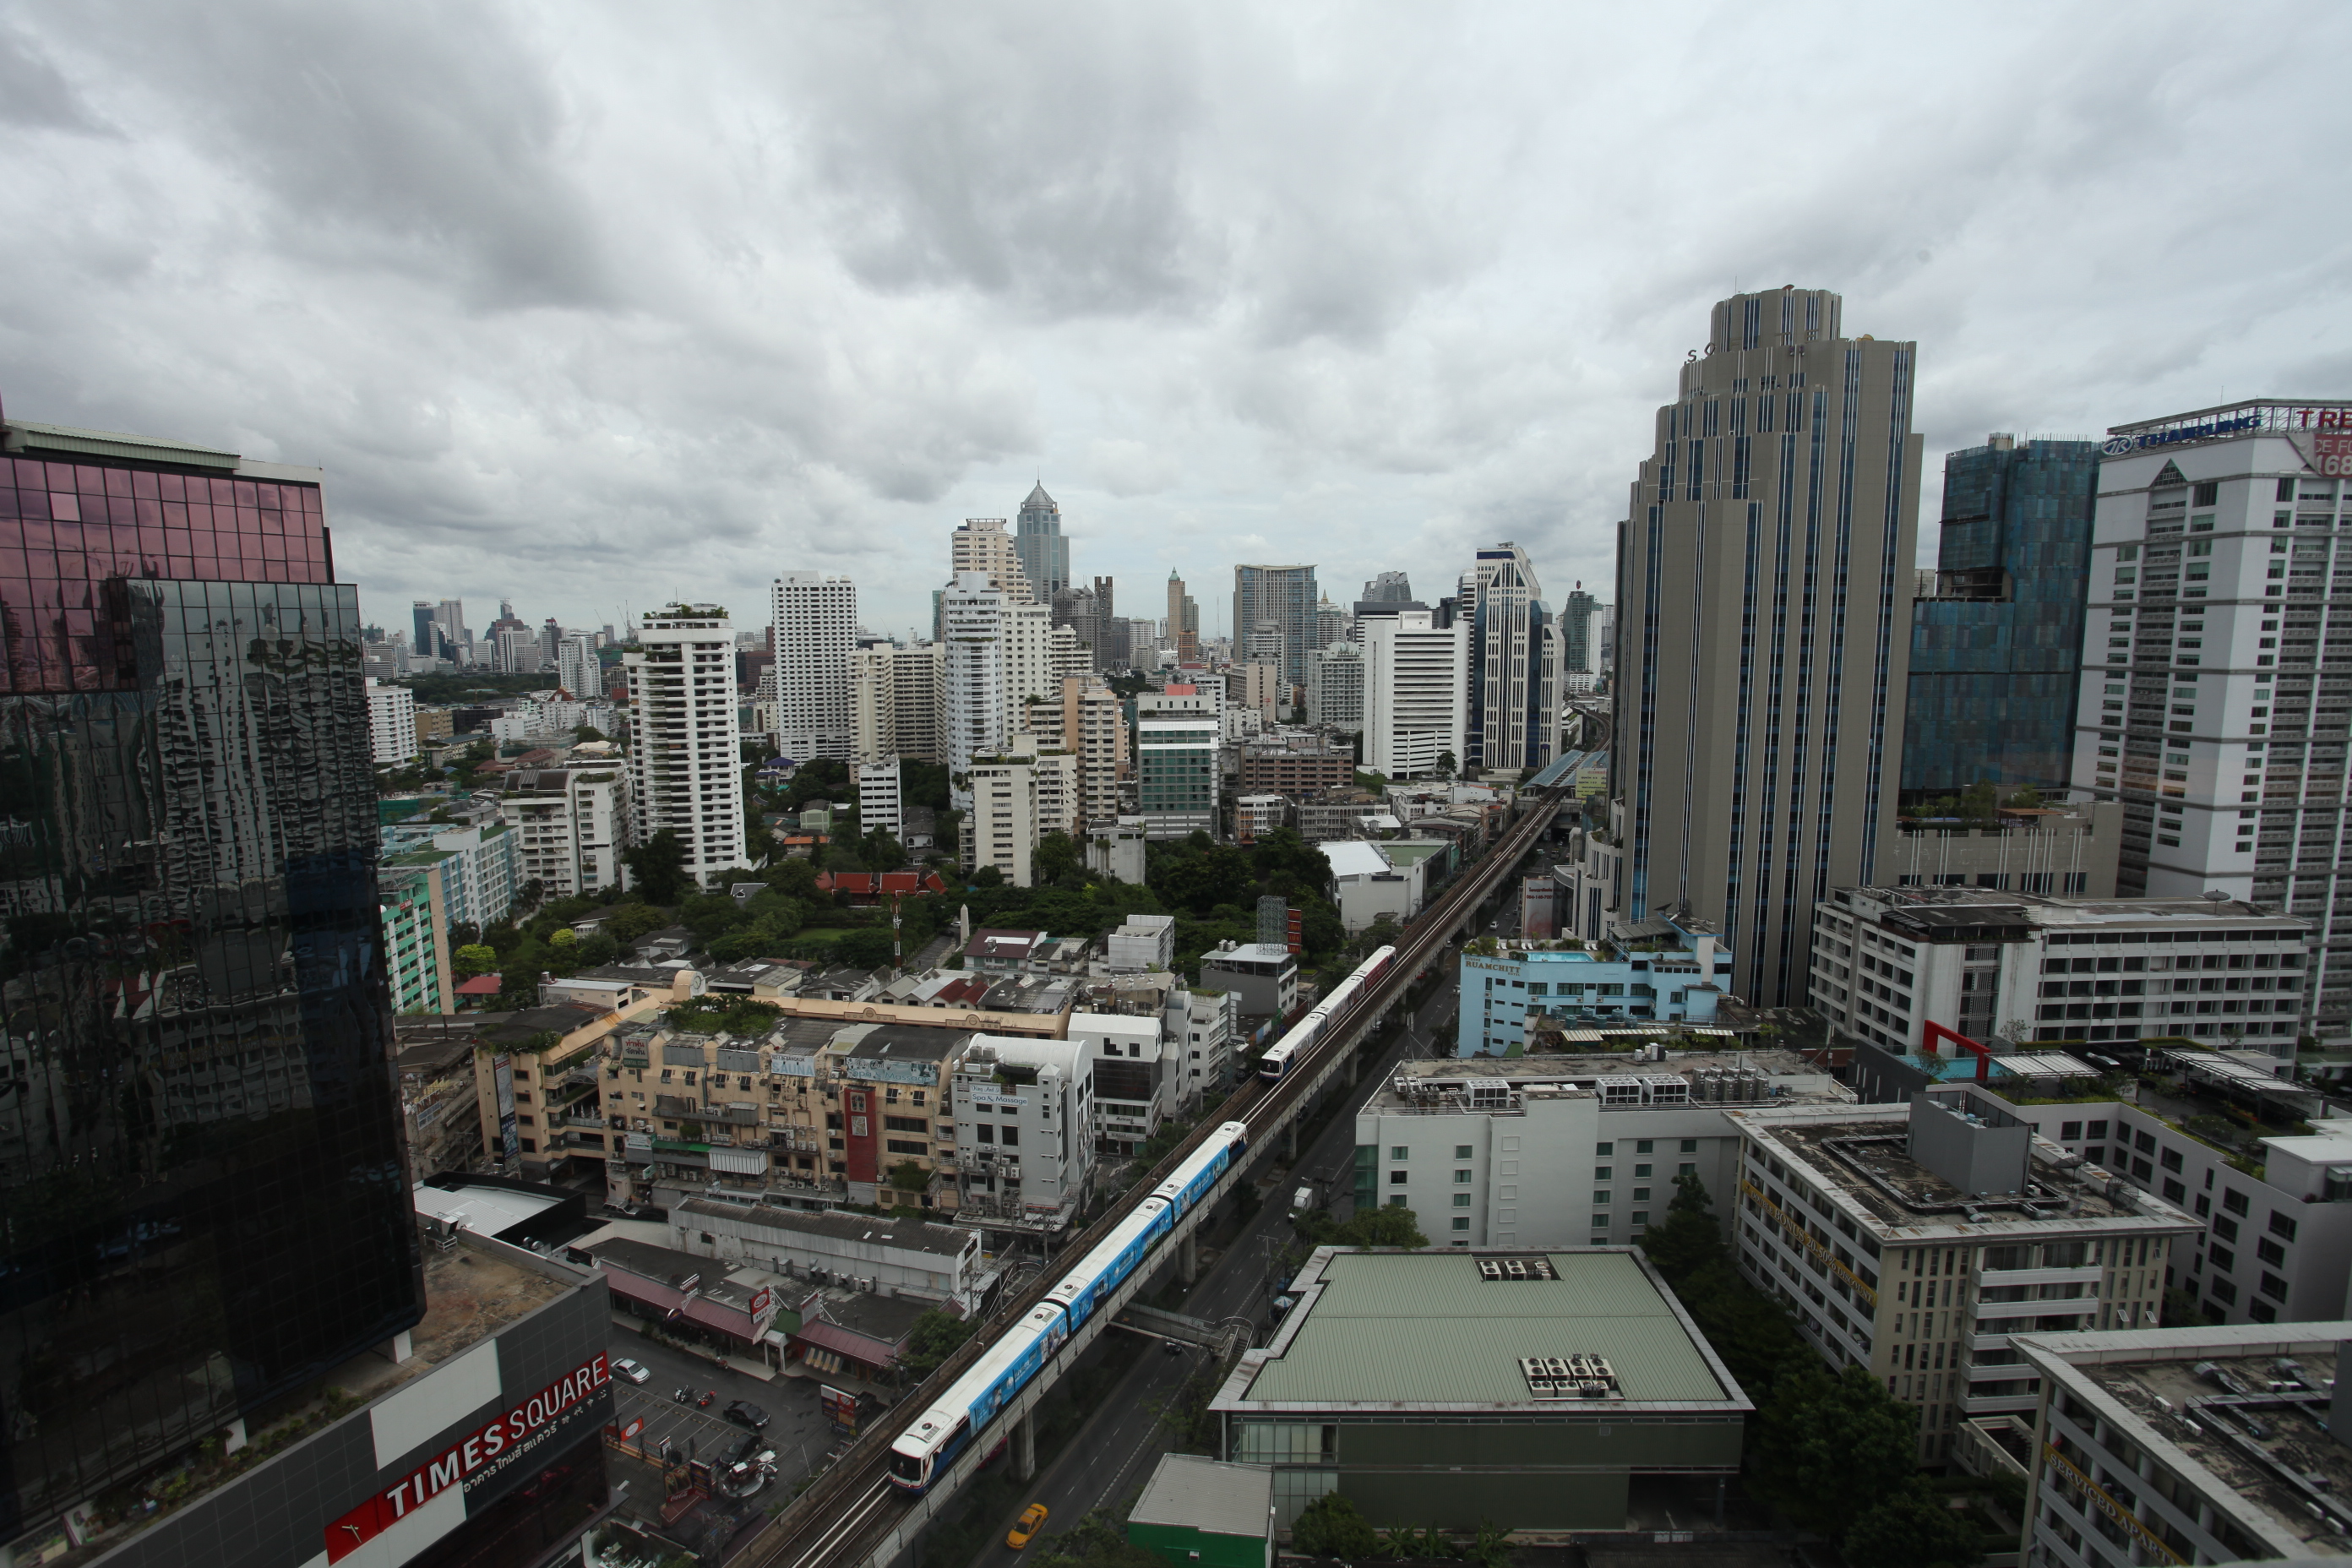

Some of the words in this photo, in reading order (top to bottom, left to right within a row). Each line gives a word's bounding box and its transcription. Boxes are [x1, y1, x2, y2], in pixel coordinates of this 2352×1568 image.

[1466, 961, 1522, 973] RUAMCHITT
[771, 1062, 814, 1076] SAUNA
[885, 1071, 931, 1084] Massage
[995, 1096, 1027, 1105] Massage
[1750, 1190, 1773, 1217] DOUBLE
[1774, 1207, 1805, 1244] BONUS
[1806, 1235, 1838, 1271] 20-50%
[1837, 1268, 1874, 1303] DISCOUNT
[385, 1422, 505, 1519] TIMES
[509, 1355, 607, 1440] SQUARE
[2050, 1452, 2118, 1518] SERVICED
